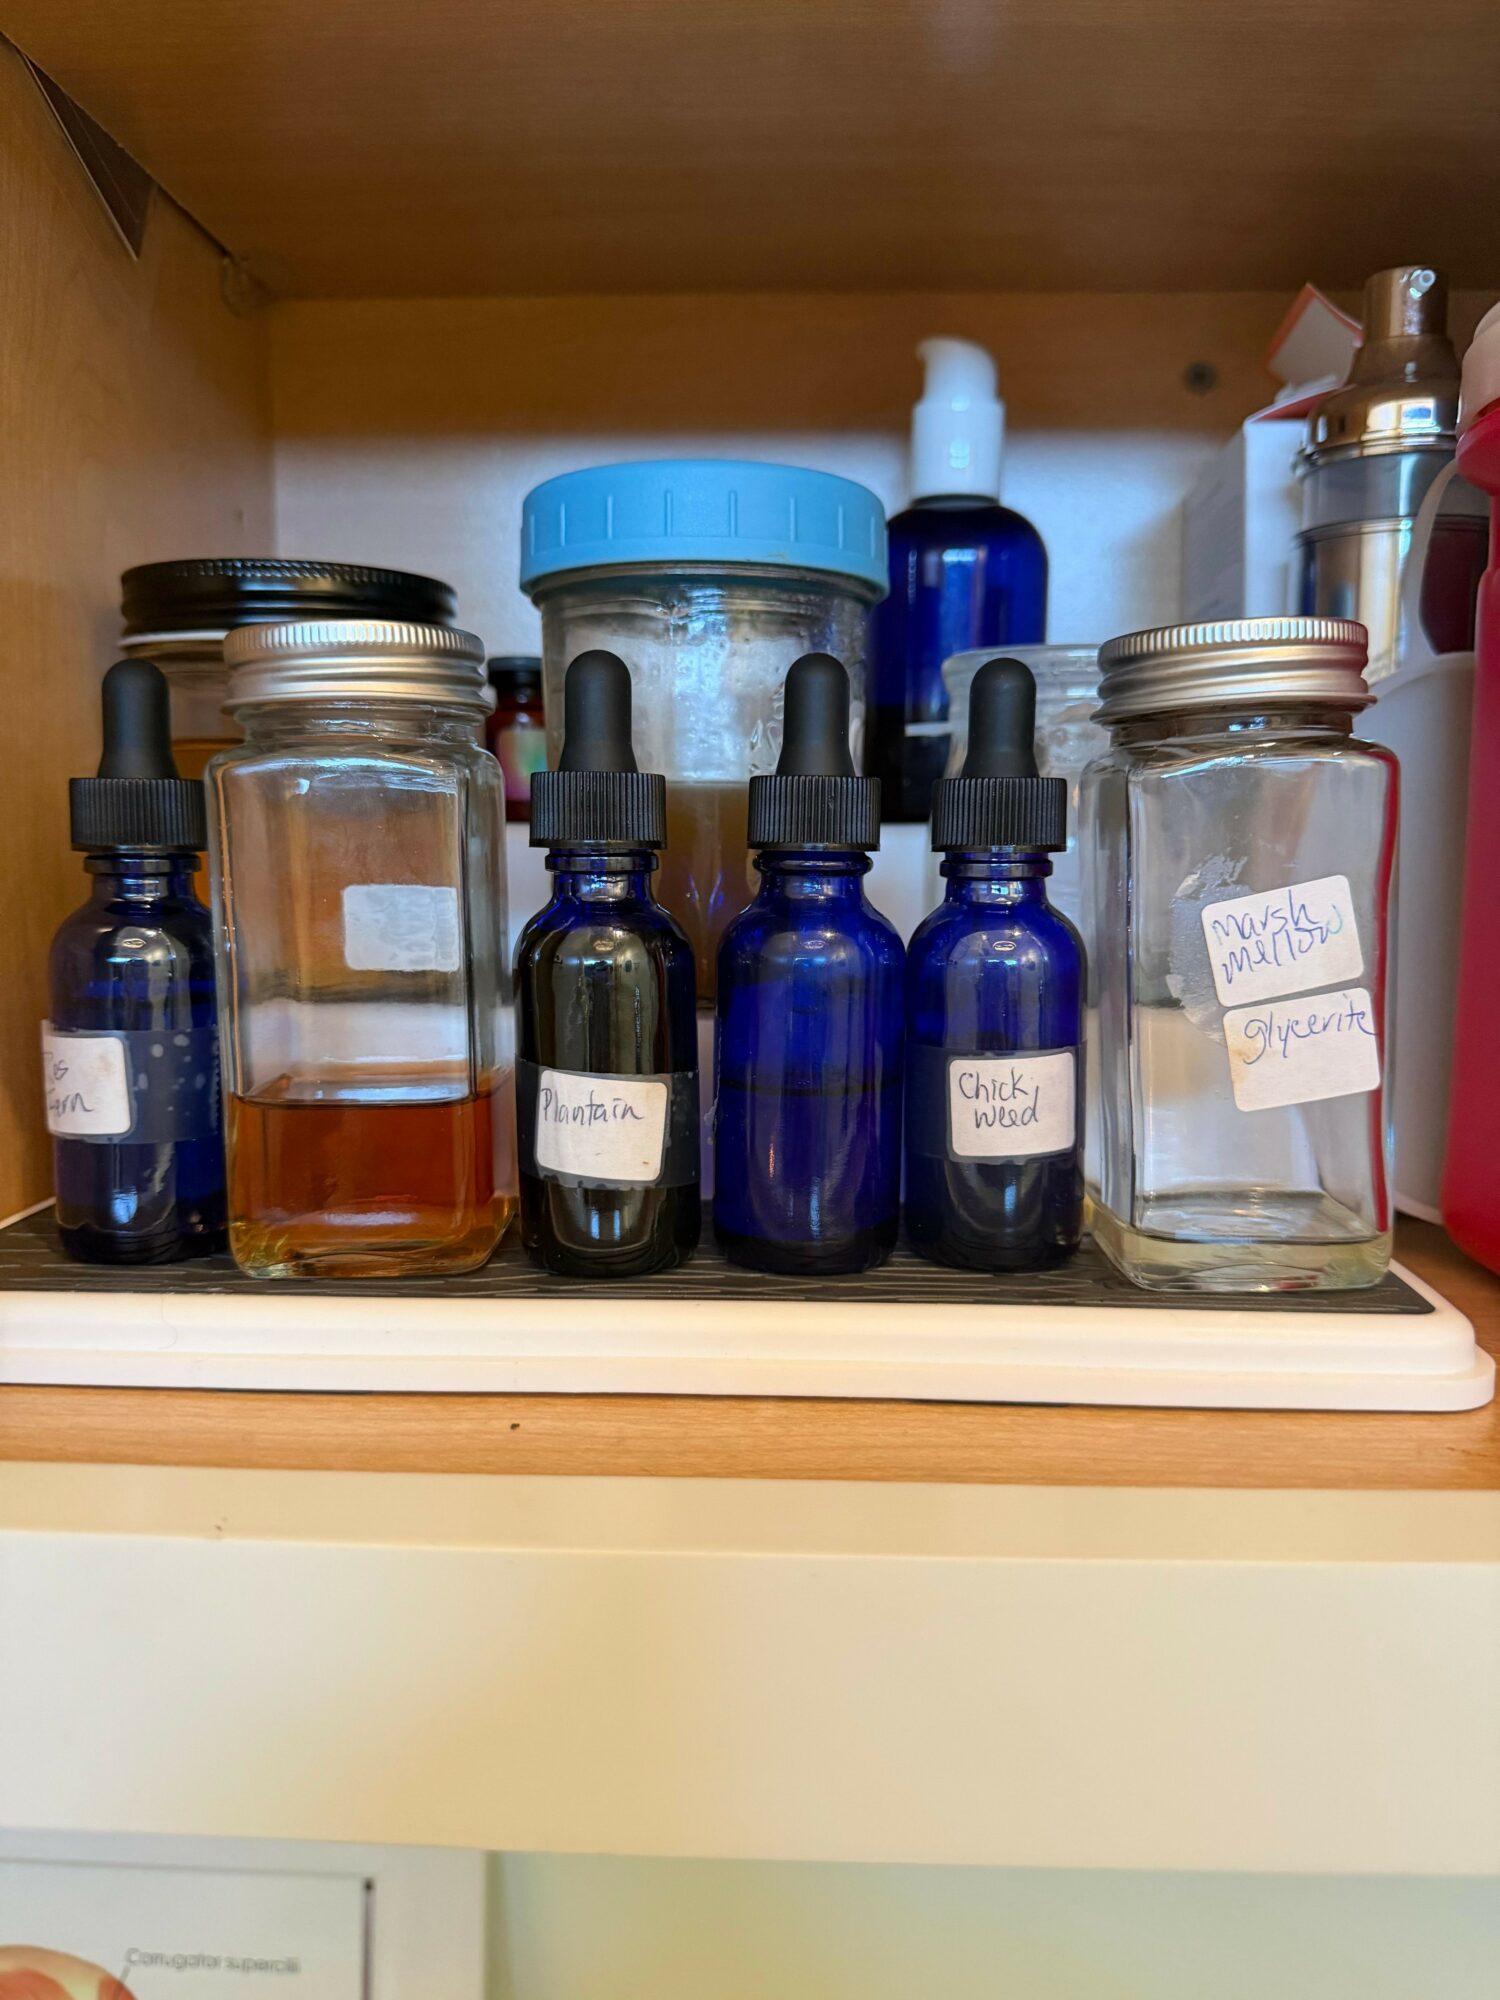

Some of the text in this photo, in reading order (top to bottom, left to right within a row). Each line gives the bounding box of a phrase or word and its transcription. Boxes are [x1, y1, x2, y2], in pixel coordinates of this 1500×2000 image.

[1243, 993, 1378, 1065] glycerite
[959, 1067, 1029, 1103] Chick
[541, 1087, 644, 1127] Plantain
